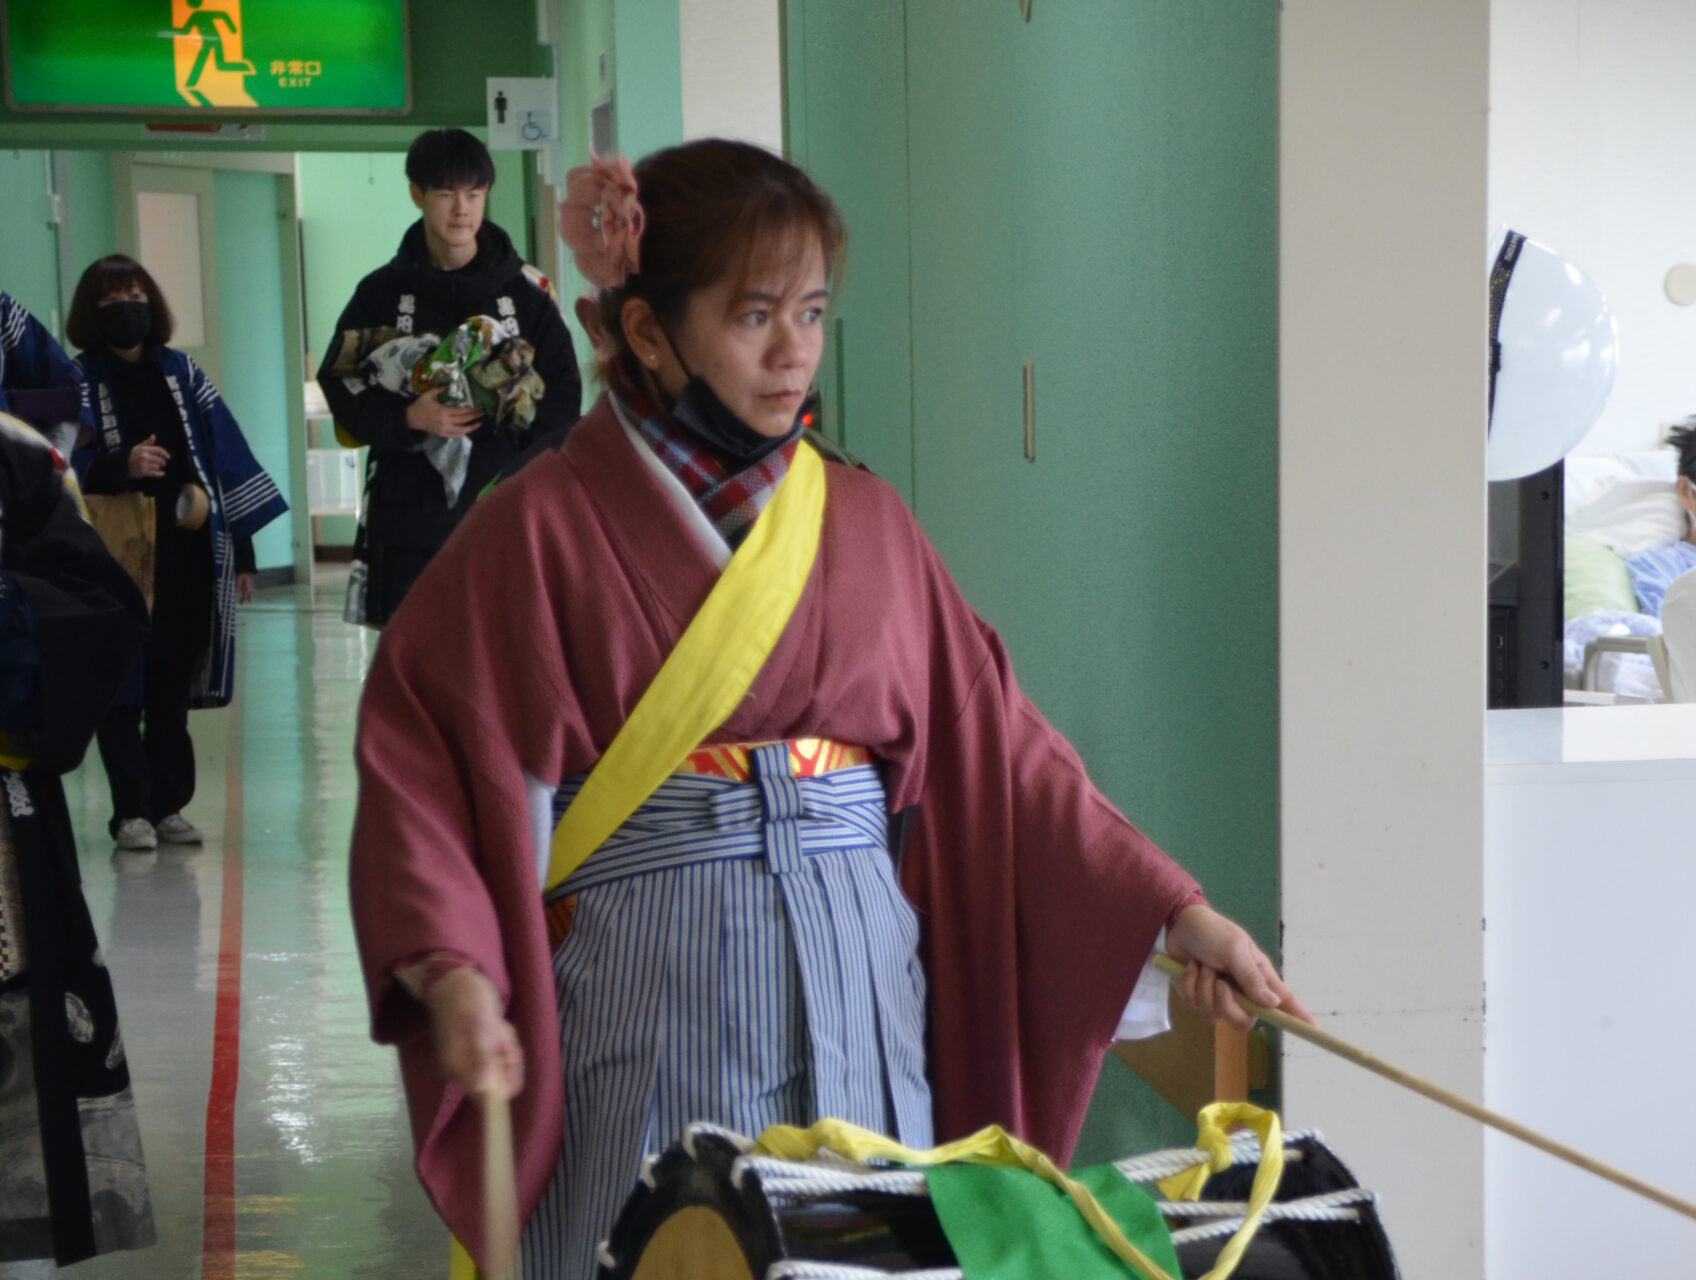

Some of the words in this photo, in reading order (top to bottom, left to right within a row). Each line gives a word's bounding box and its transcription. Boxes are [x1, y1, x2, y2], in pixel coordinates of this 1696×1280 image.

[270, 60, 321, 75] 非常口
[278, 77, 311, 88] EXIT
